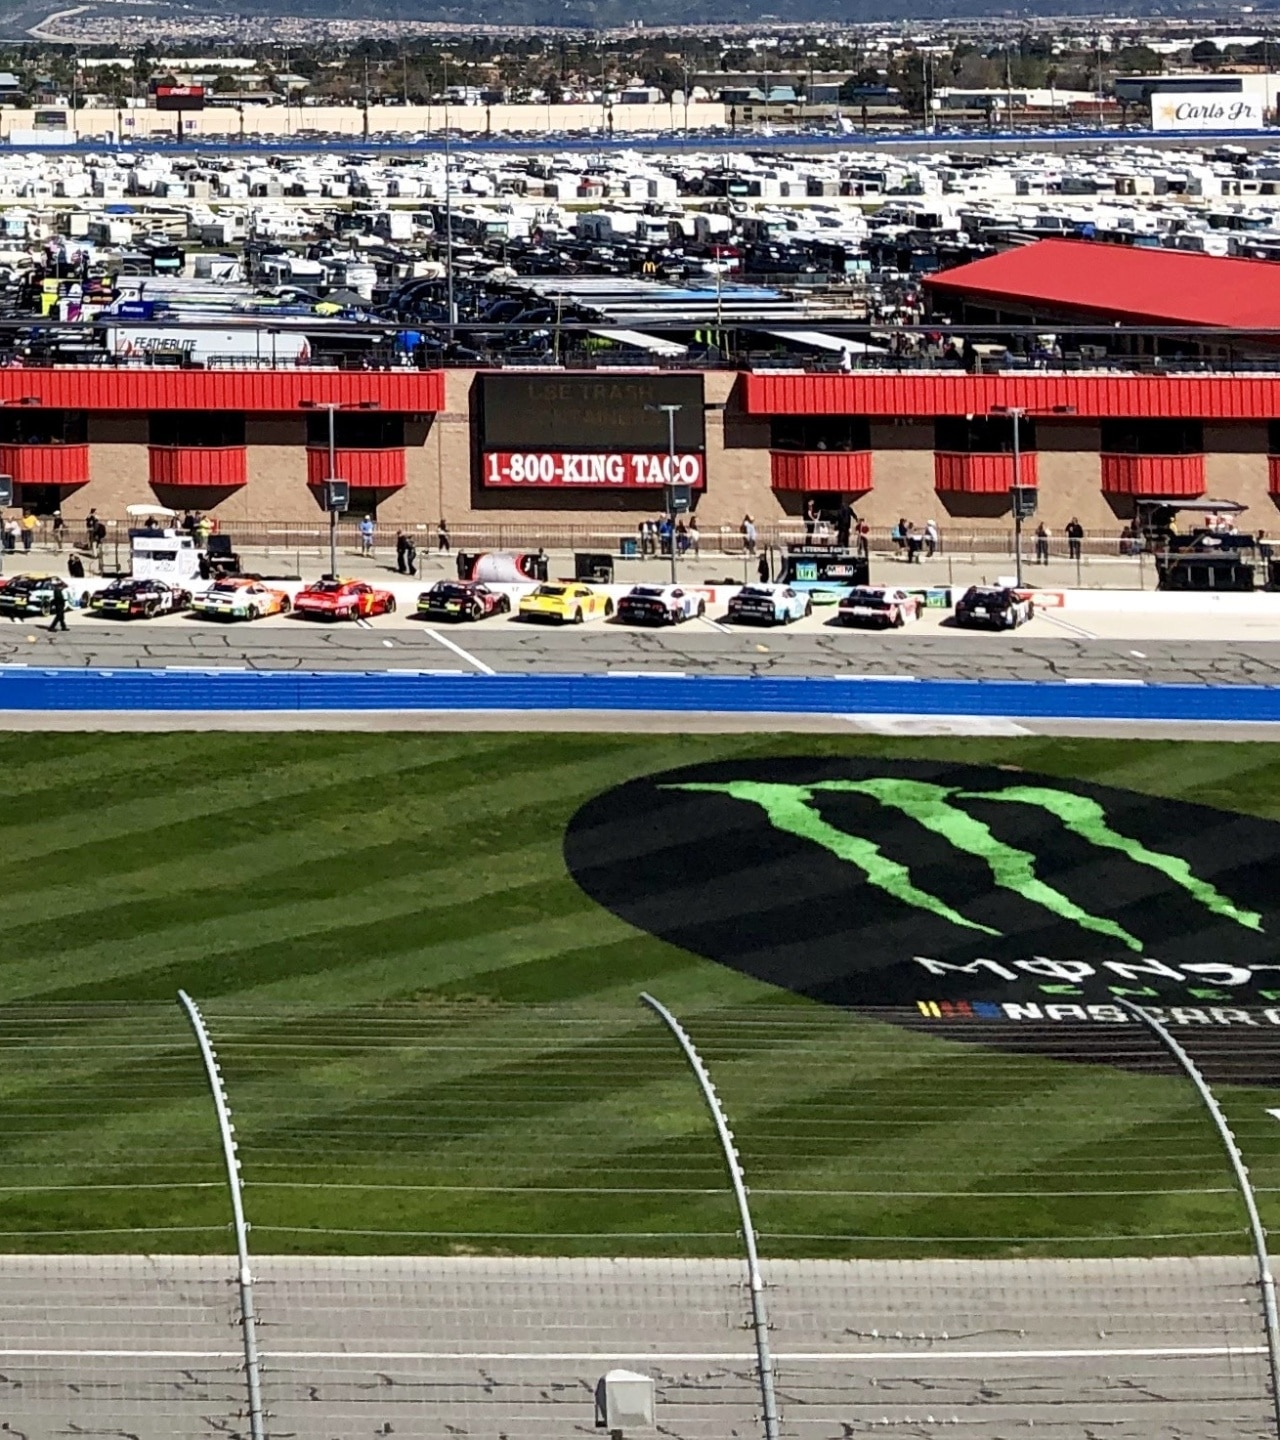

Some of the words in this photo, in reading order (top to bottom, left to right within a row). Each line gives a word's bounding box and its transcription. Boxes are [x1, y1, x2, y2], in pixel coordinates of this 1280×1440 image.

[134, 337, 197, 351] FEATHERLITE
[488, 454, 625, 482] 1-800-KING
[632, 455, 700, 483] TACO
[913, 956, 1280, 986] MONS
[1001, 1002, 1259, 1027] NASCAR
